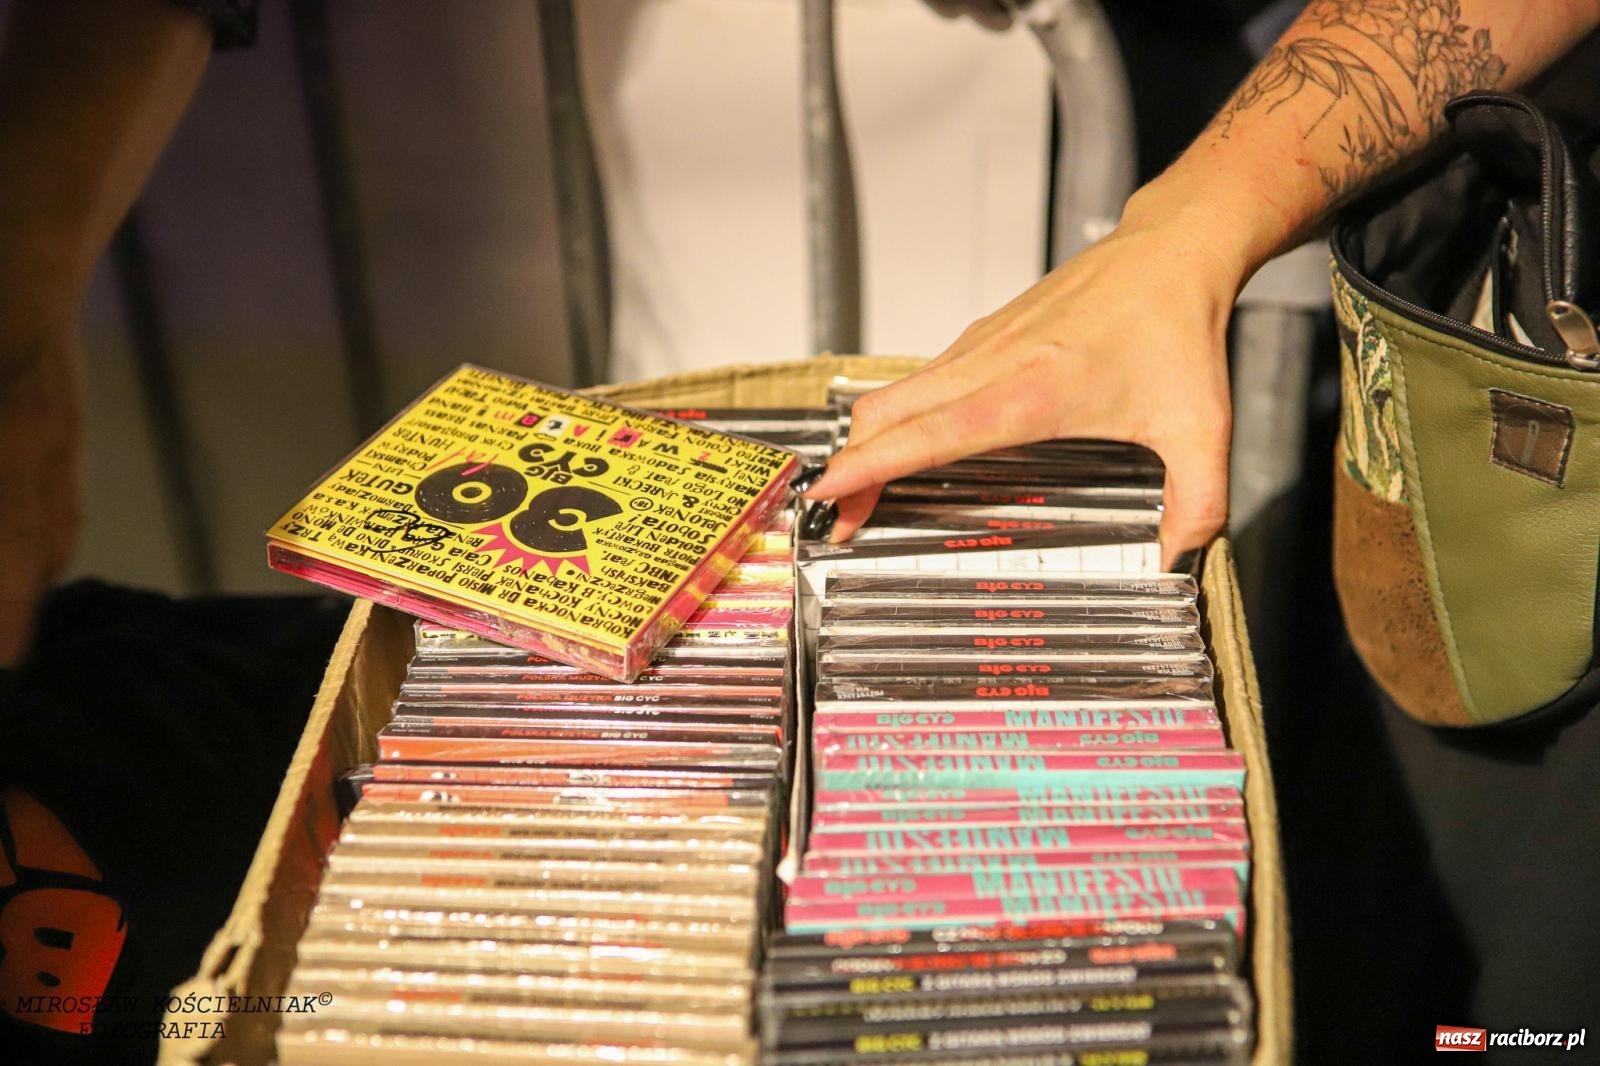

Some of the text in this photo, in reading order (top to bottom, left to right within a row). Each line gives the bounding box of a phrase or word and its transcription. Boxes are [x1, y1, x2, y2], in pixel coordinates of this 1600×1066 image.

[517, 443, 611, 478] CYC
[524, 465, 571, 485] BIG
[975, 581, 1045, 593] BIG CYC
[974, 609, 1045, 621] BIG CYC
[973, 637, 1045, 650] BIG CYC
[978, 664, 1051, 677] BIG CYC
[568, 673, 610, 682] MUZYK
[975, 683, 1050, 698] BIG CYC
[516, 693, 660, 703] POLSKA MUZYKA BIG CYC
